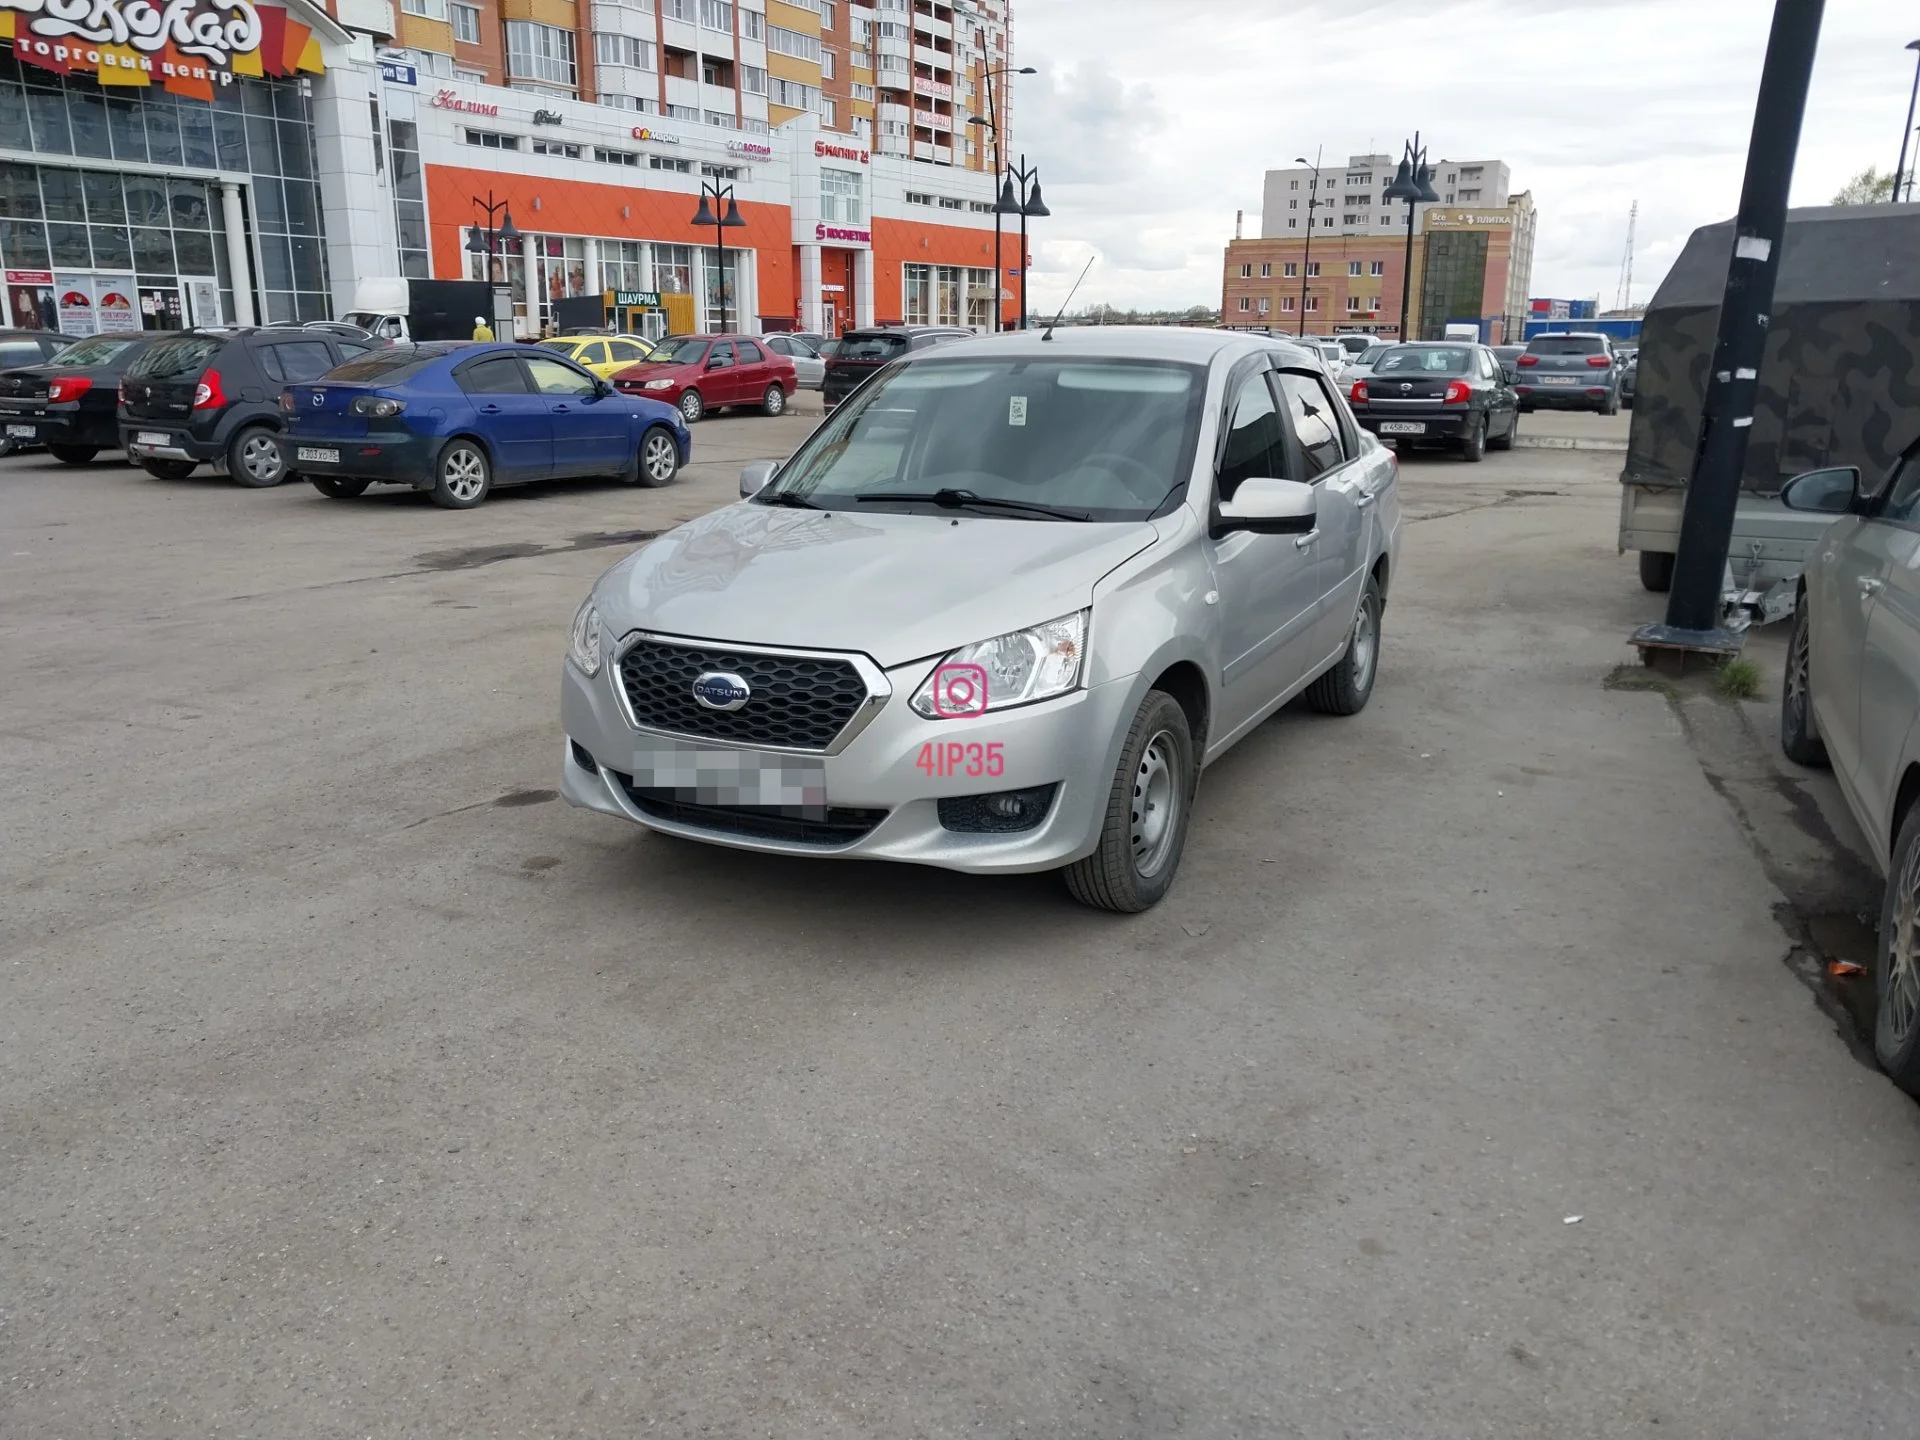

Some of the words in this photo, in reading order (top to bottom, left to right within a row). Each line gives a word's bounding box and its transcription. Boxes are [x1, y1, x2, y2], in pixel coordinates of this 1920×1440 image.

[0, 0, 262, 65] околад
[17, 38, 152, 71] торговый
[162, 61, 232, 87] центр
[431, 89, 498, 117] Калина
[1476, 215, 1512, 224] ПЛИТКА
[617, 292, 658, 305] ШАУРМА
[696, 685, 743, 698] DATSUN
